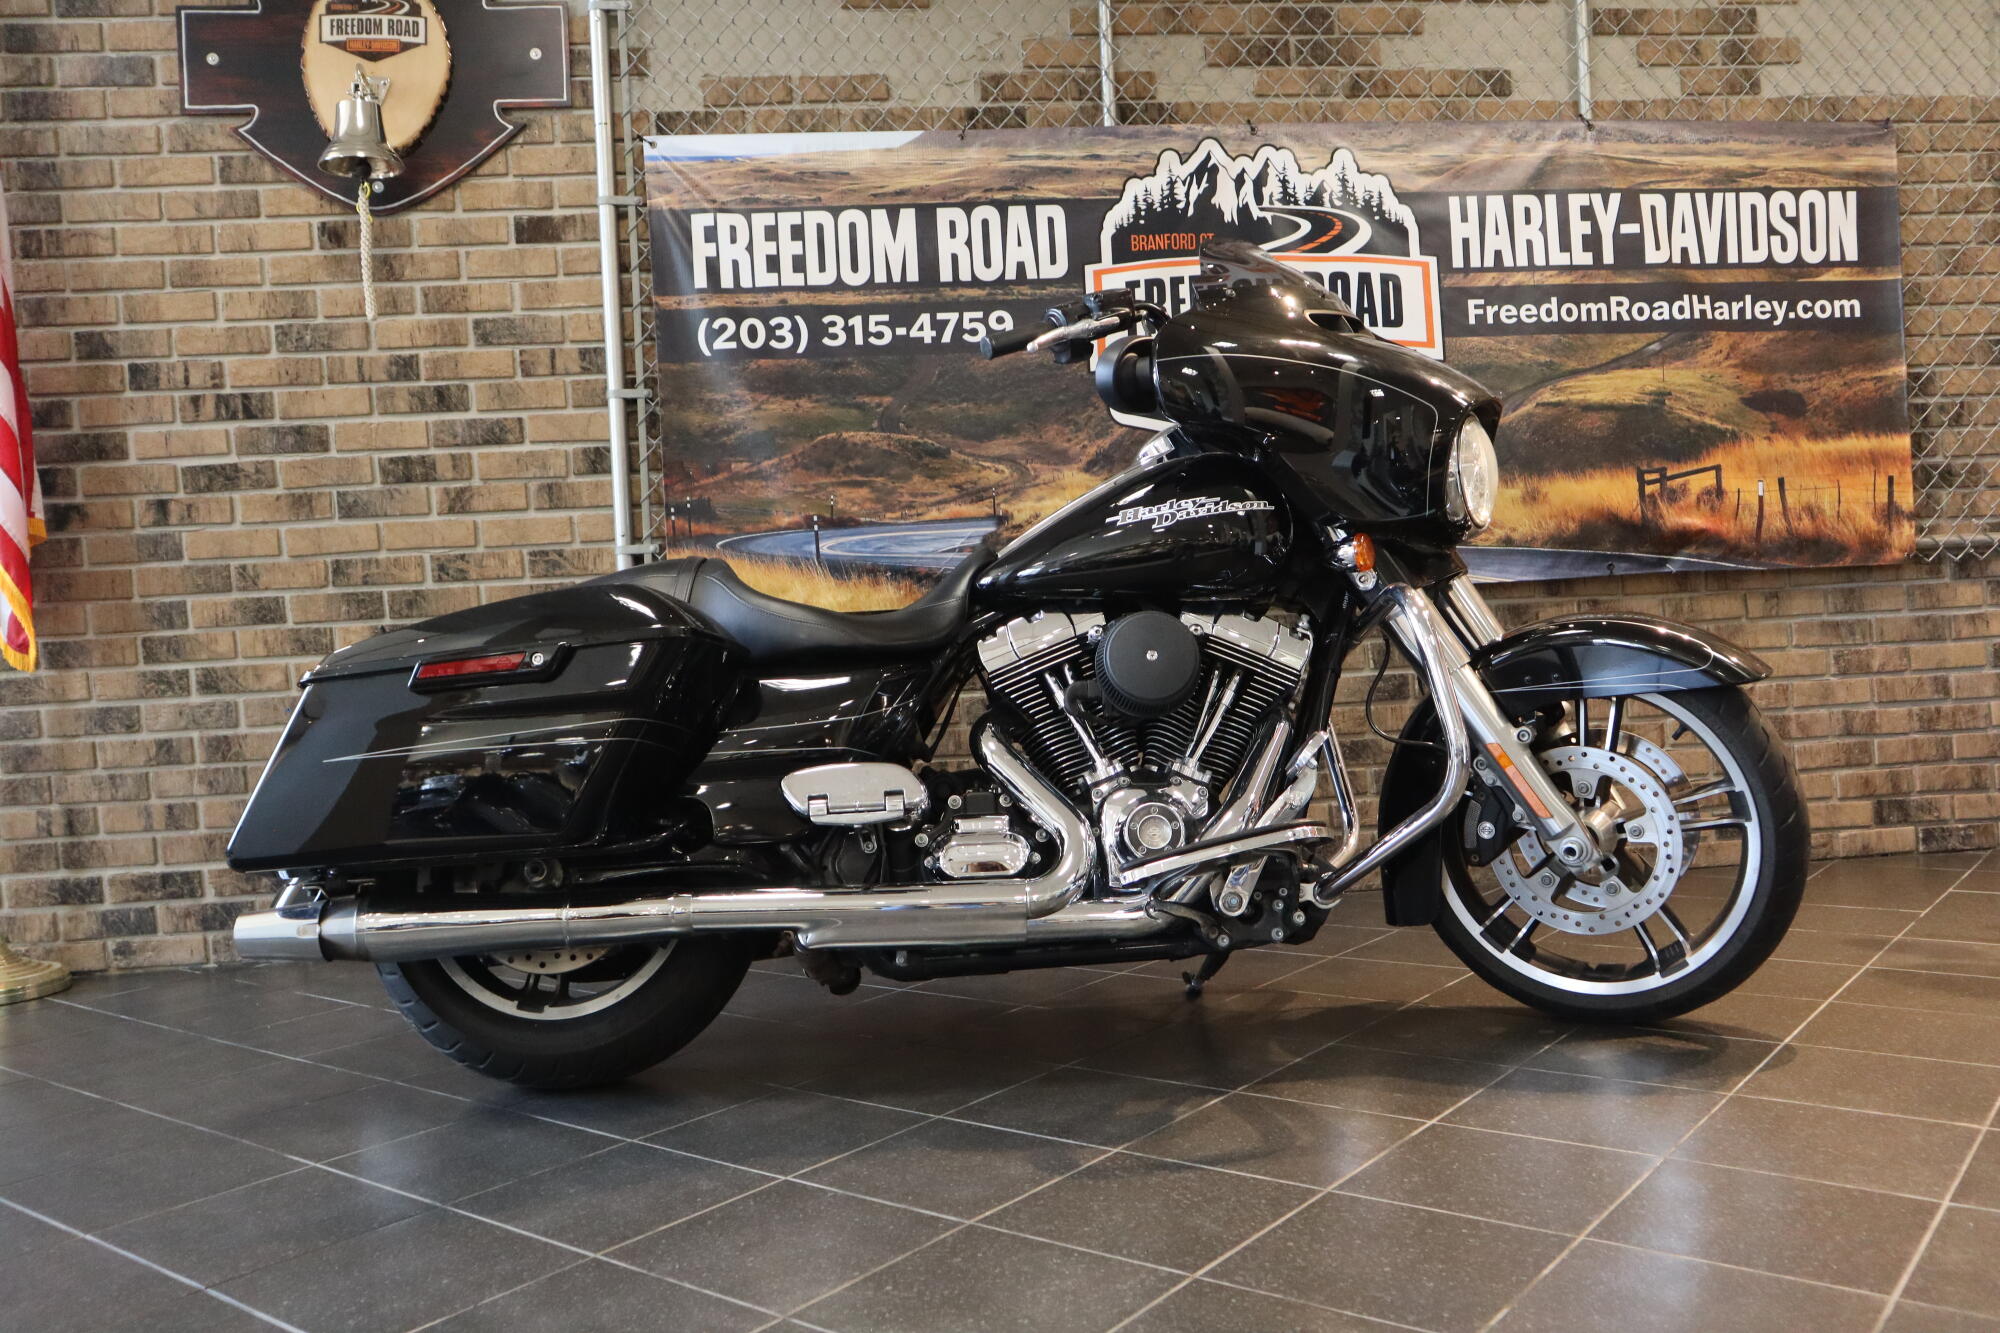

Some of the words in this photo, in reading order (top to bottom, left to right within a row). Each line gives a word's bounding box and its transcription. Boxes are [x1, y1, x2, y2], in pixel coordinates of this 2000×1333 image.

[330, 17, 382, 36] FREEDOM
[388, 19, 419, 37] ROAD
[1130, 233, 1196, 251] BRANFORD
[1448, 189, 1859, 269] HARLEY-DAVIDSON
[690, 207, 919, 289] FREEDOM
[936, 204, 1069, 284] ROAD
[1303, 271, 1404, 328] OAD
[1467, 294, 1861, 326] FreedomRoadHarley.com
[697, 314, 808, 357] (203)
[821, 310, 1014, 347] 315-4759
[1107, 497, 1219, 527] Harley
[1151, 500, 1275, 530] Davidson
